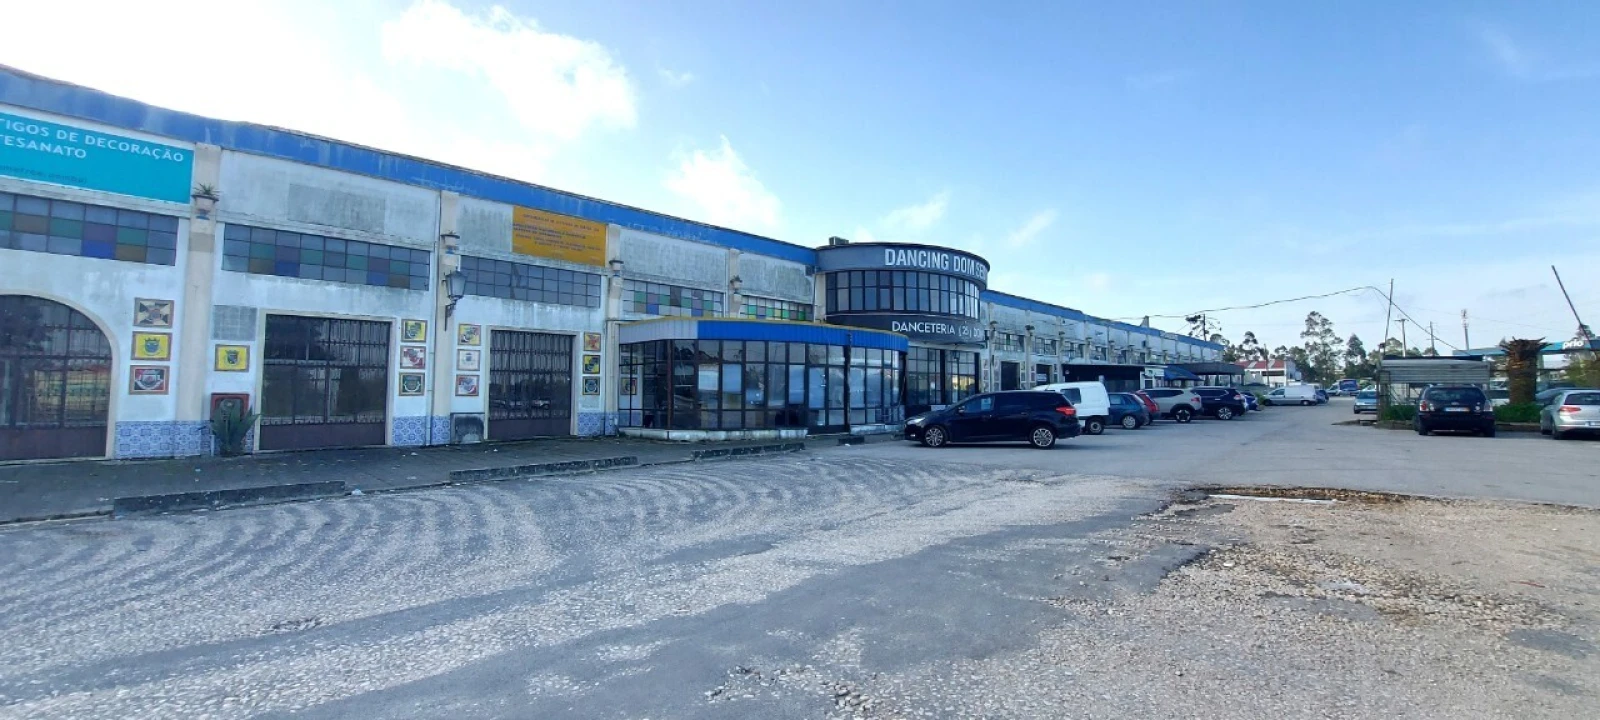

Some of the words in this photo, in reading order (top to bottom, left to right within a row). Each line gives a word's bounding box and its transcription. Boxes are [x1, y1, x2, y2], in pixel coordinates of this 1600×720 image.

[56, 129, 79, 142] DE
[85, 135, 184, 162] DECORAÇÃO
[884, 248, 949, 270] DANCING
[953, 255, 975, 276] DOM
[892, 320, 955, 336] DANCETERIA
[1562, 339, 1585, 350] prio
